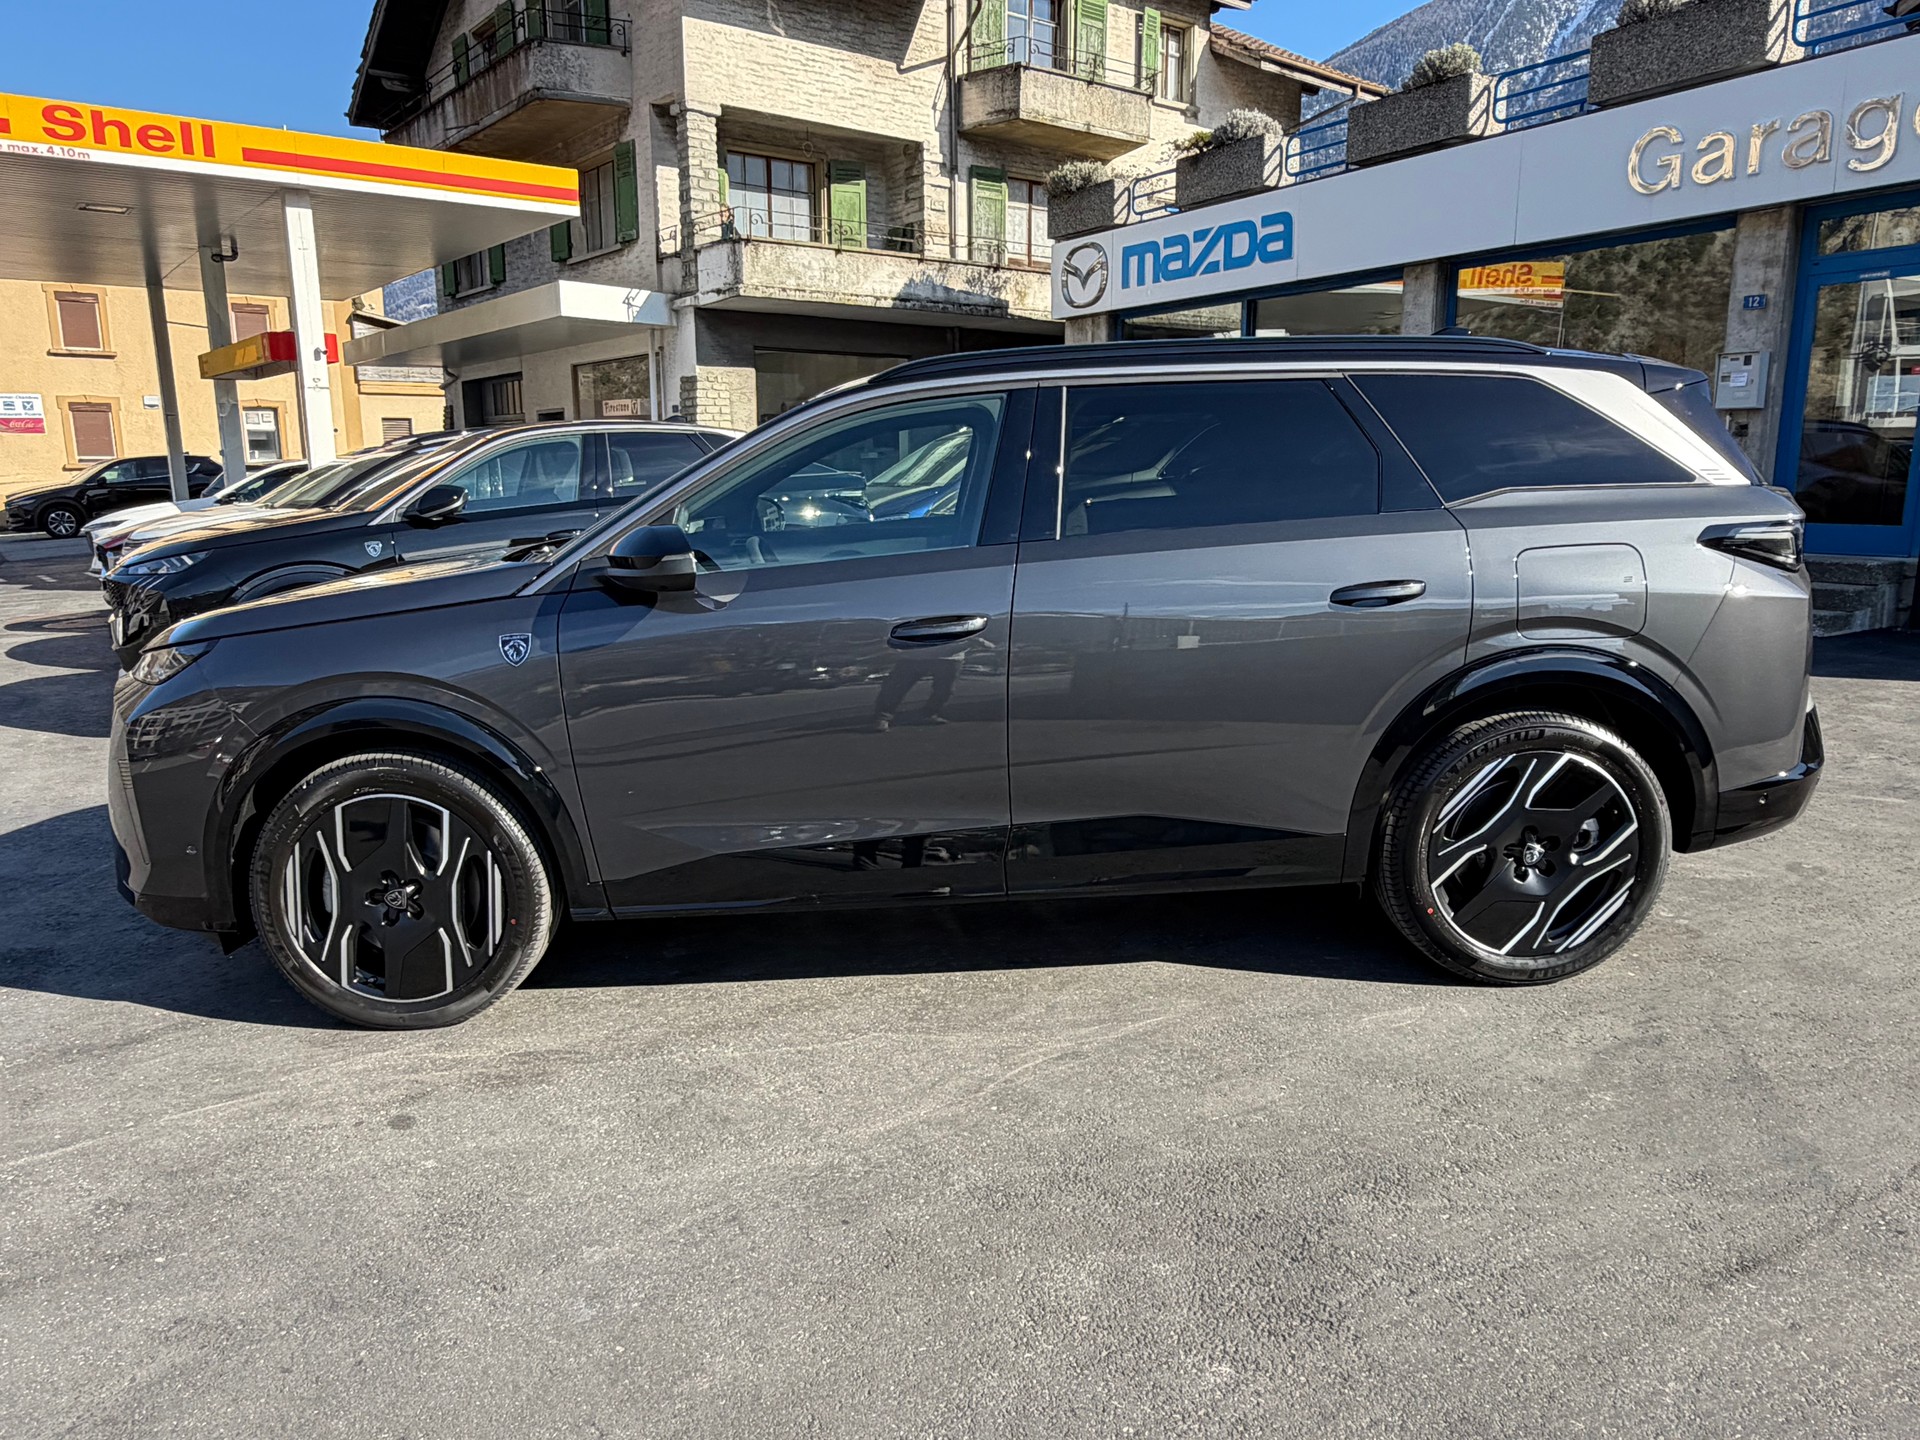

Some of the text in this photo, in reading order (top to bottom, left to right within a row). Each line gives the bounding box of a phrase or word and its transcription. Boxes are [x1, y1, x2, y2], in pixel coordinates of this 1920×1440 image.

[41, 104, 216, 158] Shell
[1627, 91, 1920, 195] Garag
[1747, 296, 1760, 307] 12
[603, 401, 630, 414] Firestone
[1455, 729, 1541, 770] MICHELIN
